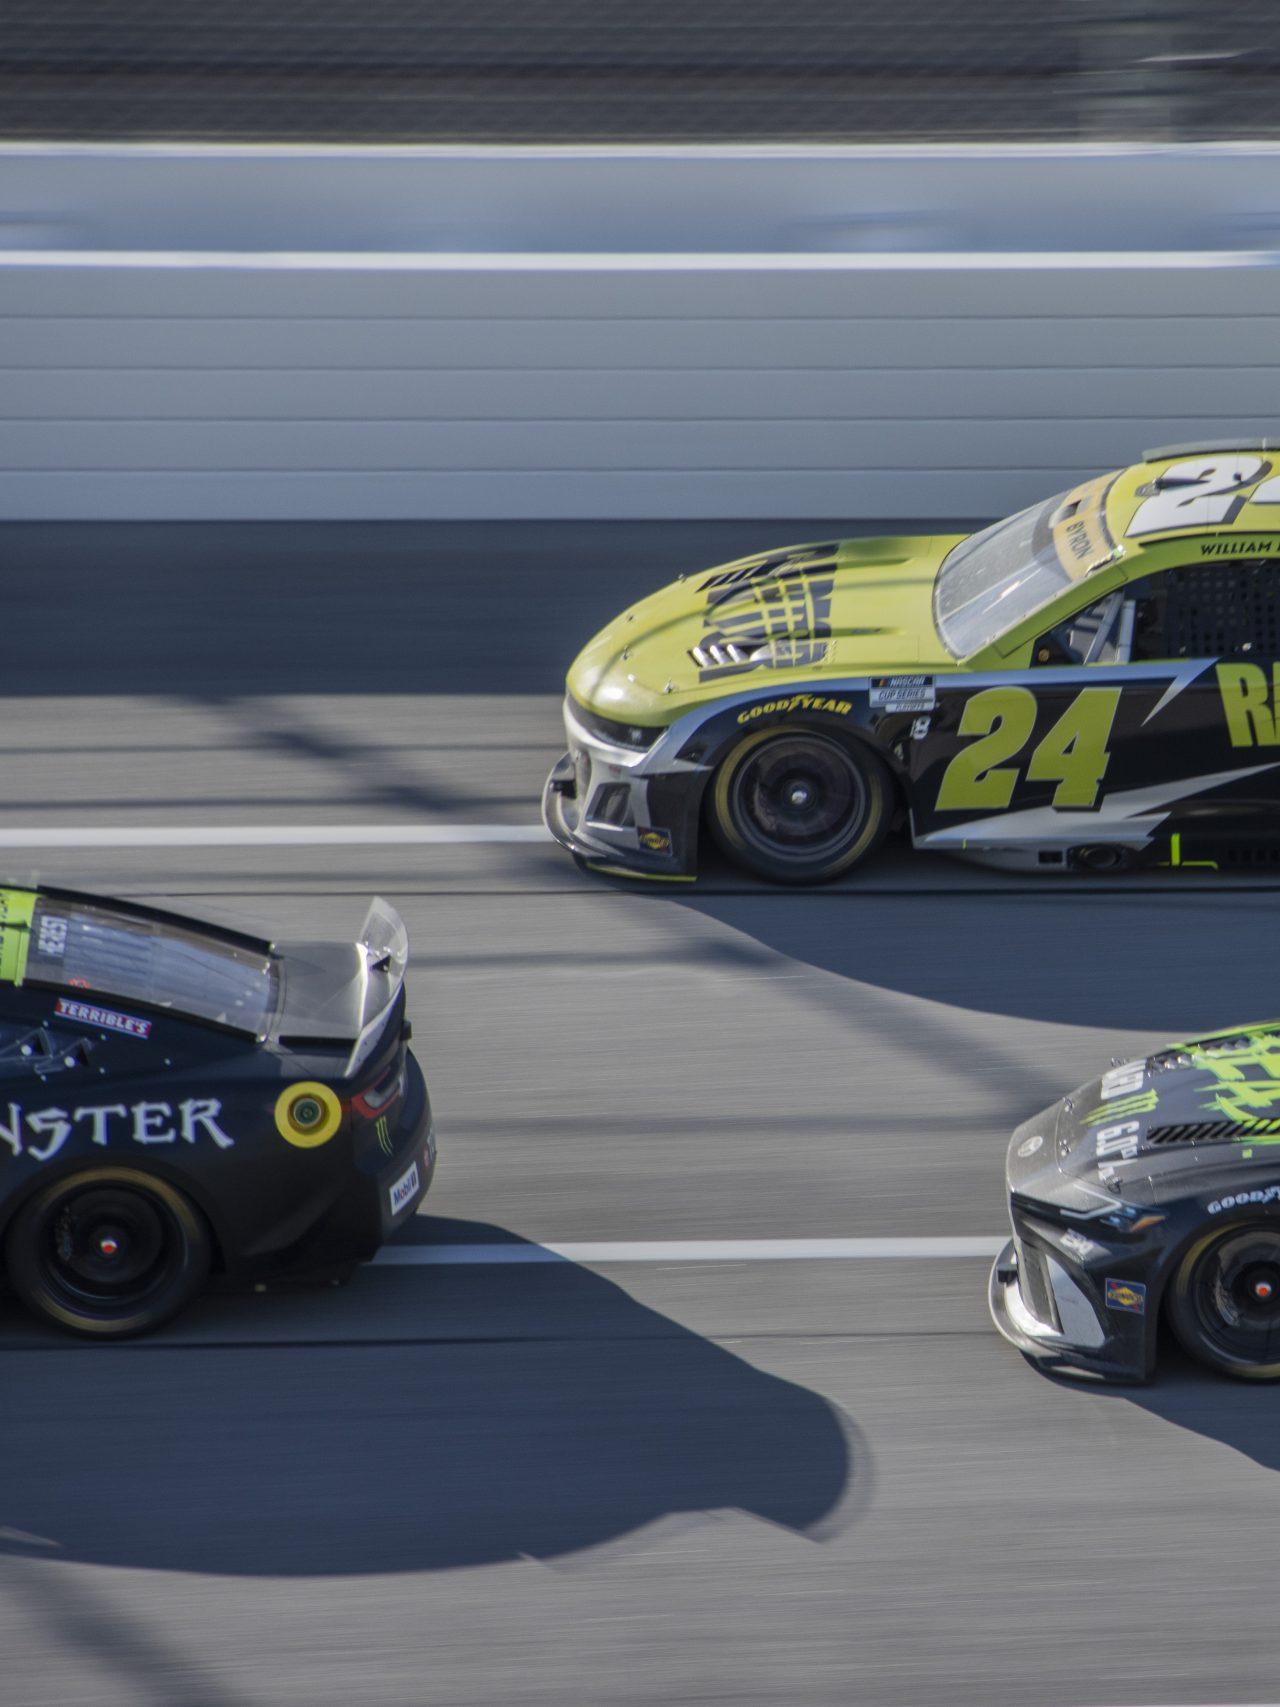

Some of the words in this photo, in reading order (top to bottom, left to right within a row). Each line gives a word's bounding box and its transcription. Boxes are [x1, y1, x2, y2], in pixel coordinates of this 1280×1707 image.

[1200, 541, 1272, 556] WILLIAM
[737, 693, 852, 724] GOODYEAR
[934, 686, 1123, 812] 24
[60, 1000, 149, 1035] TERRIBLE'S
